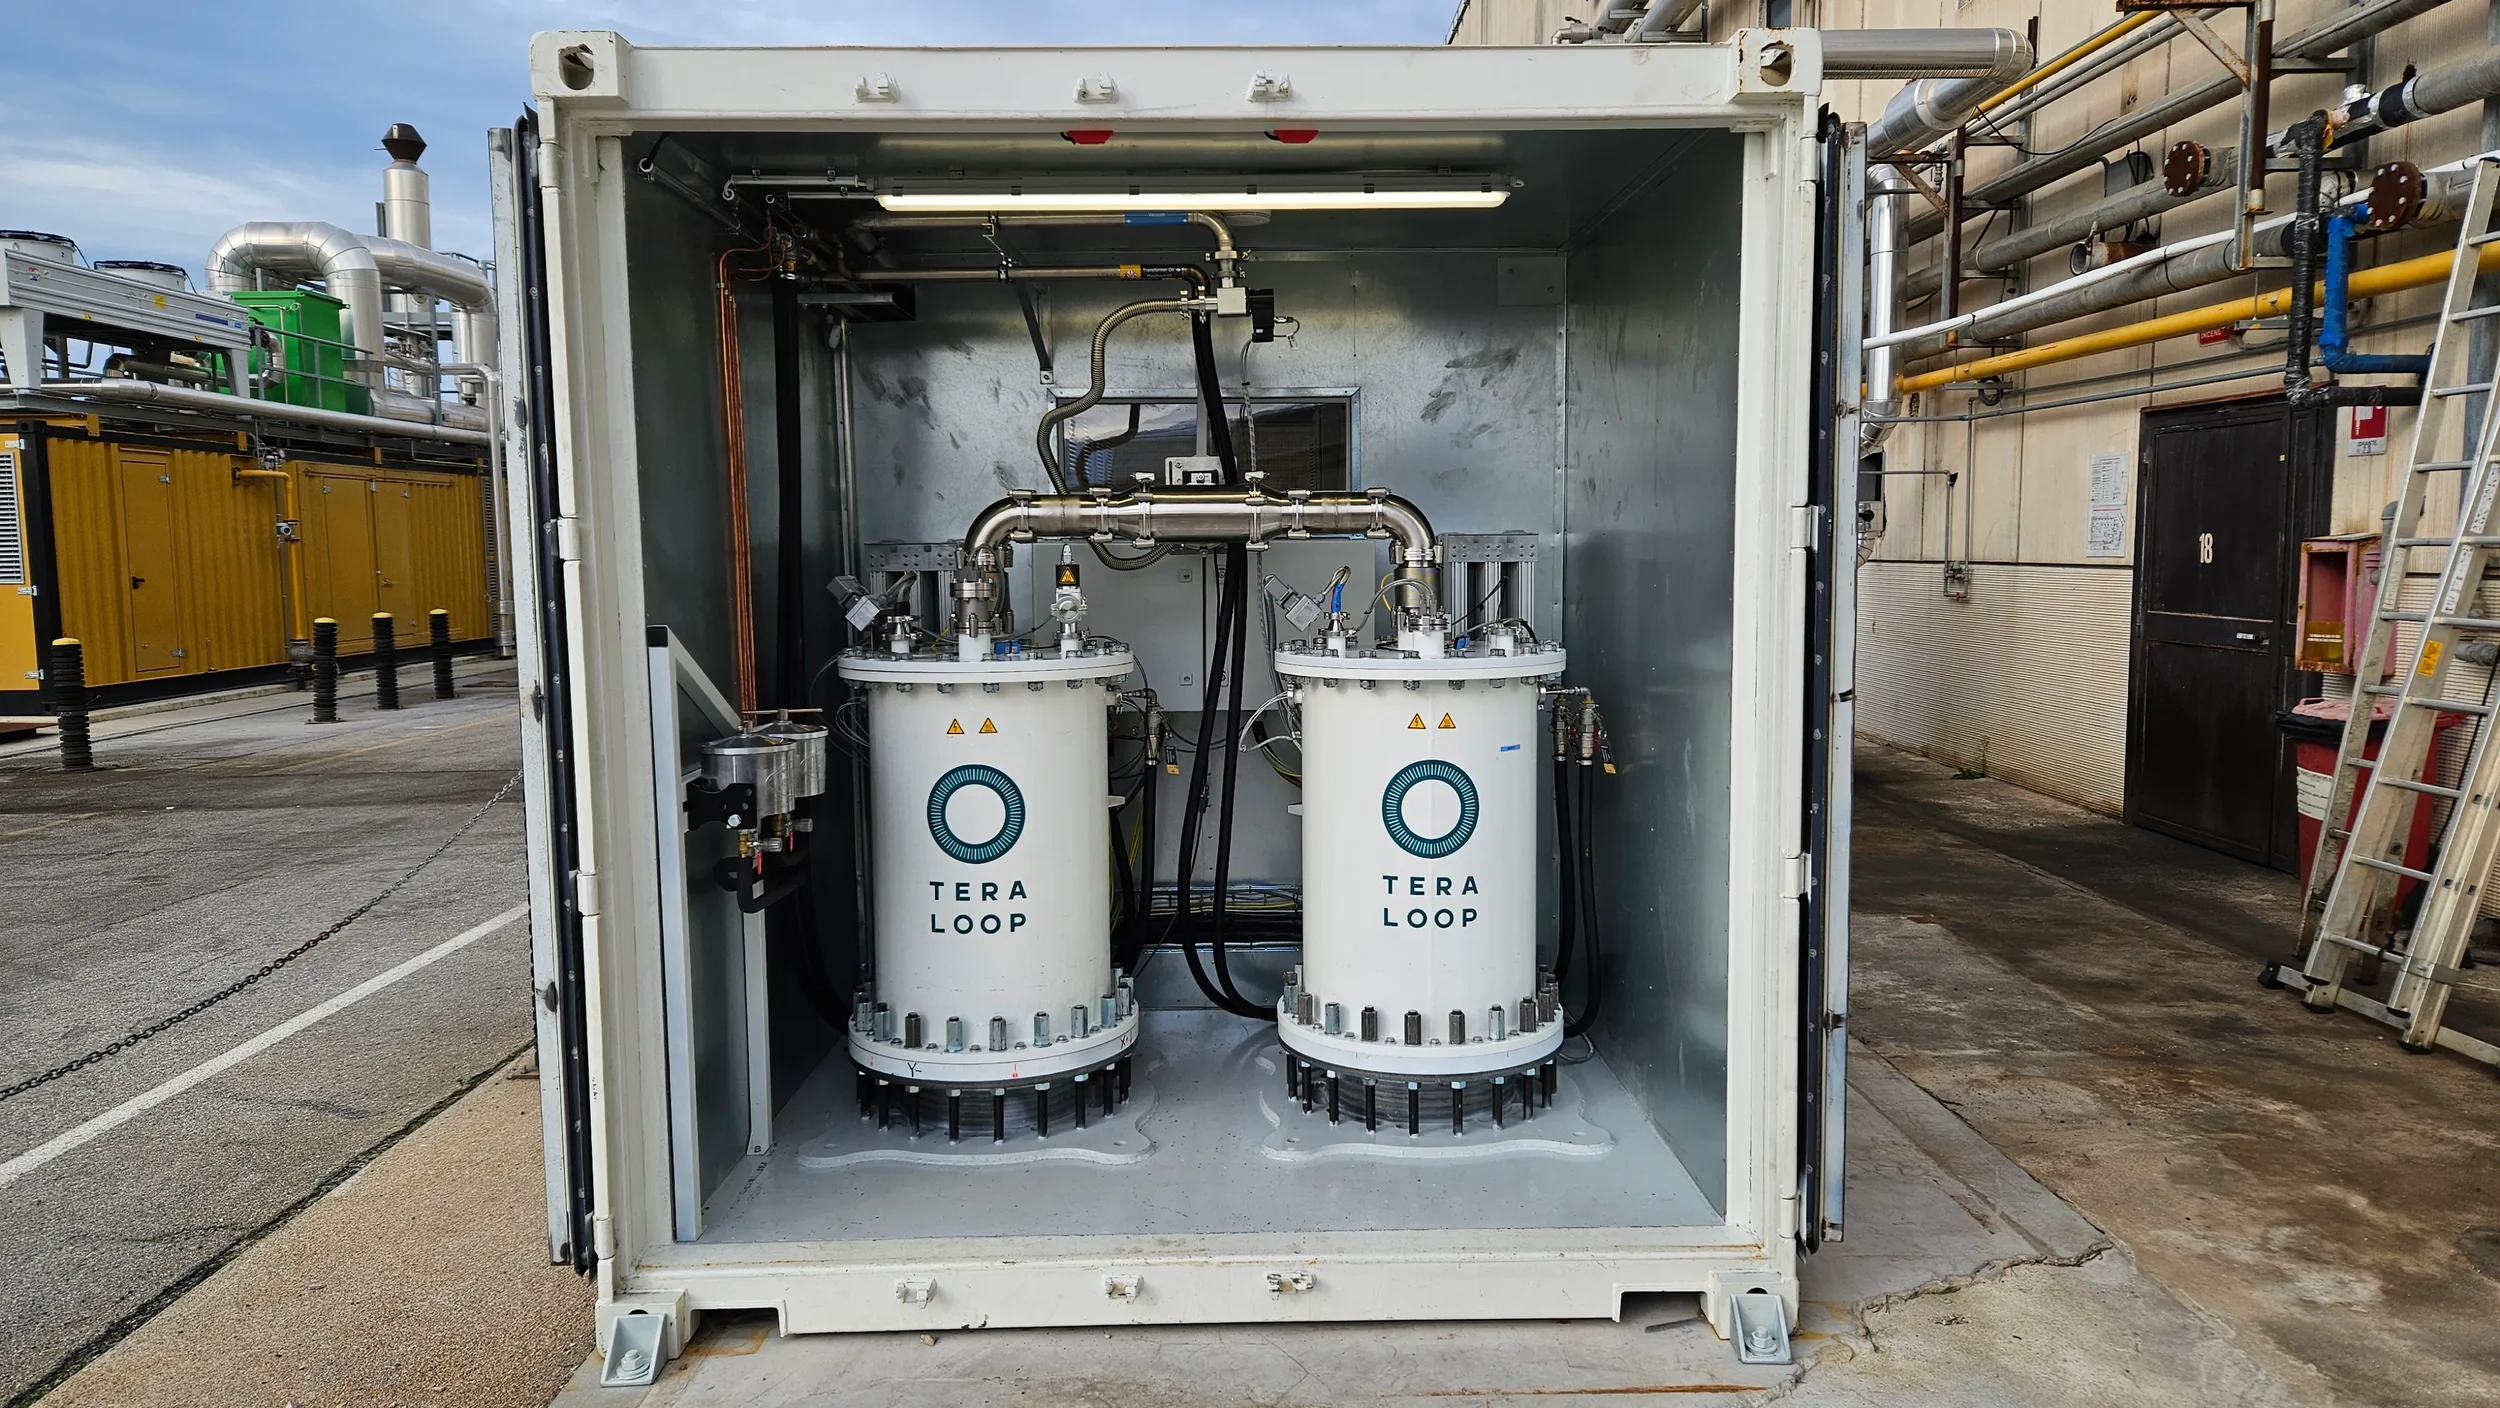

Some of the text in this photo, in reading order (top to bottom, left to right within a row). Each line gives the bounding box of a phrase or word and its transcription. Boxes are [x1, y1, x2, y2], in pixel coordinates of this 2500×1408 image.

[2199, 532, 2213, 564] 18
[929, 880, 1027, 901] TERA
[1382, 875, 1479, 896] TERA
[931, 913, 1027, 935] LOOP
[1383, 907, 1478, 929] LOOP
